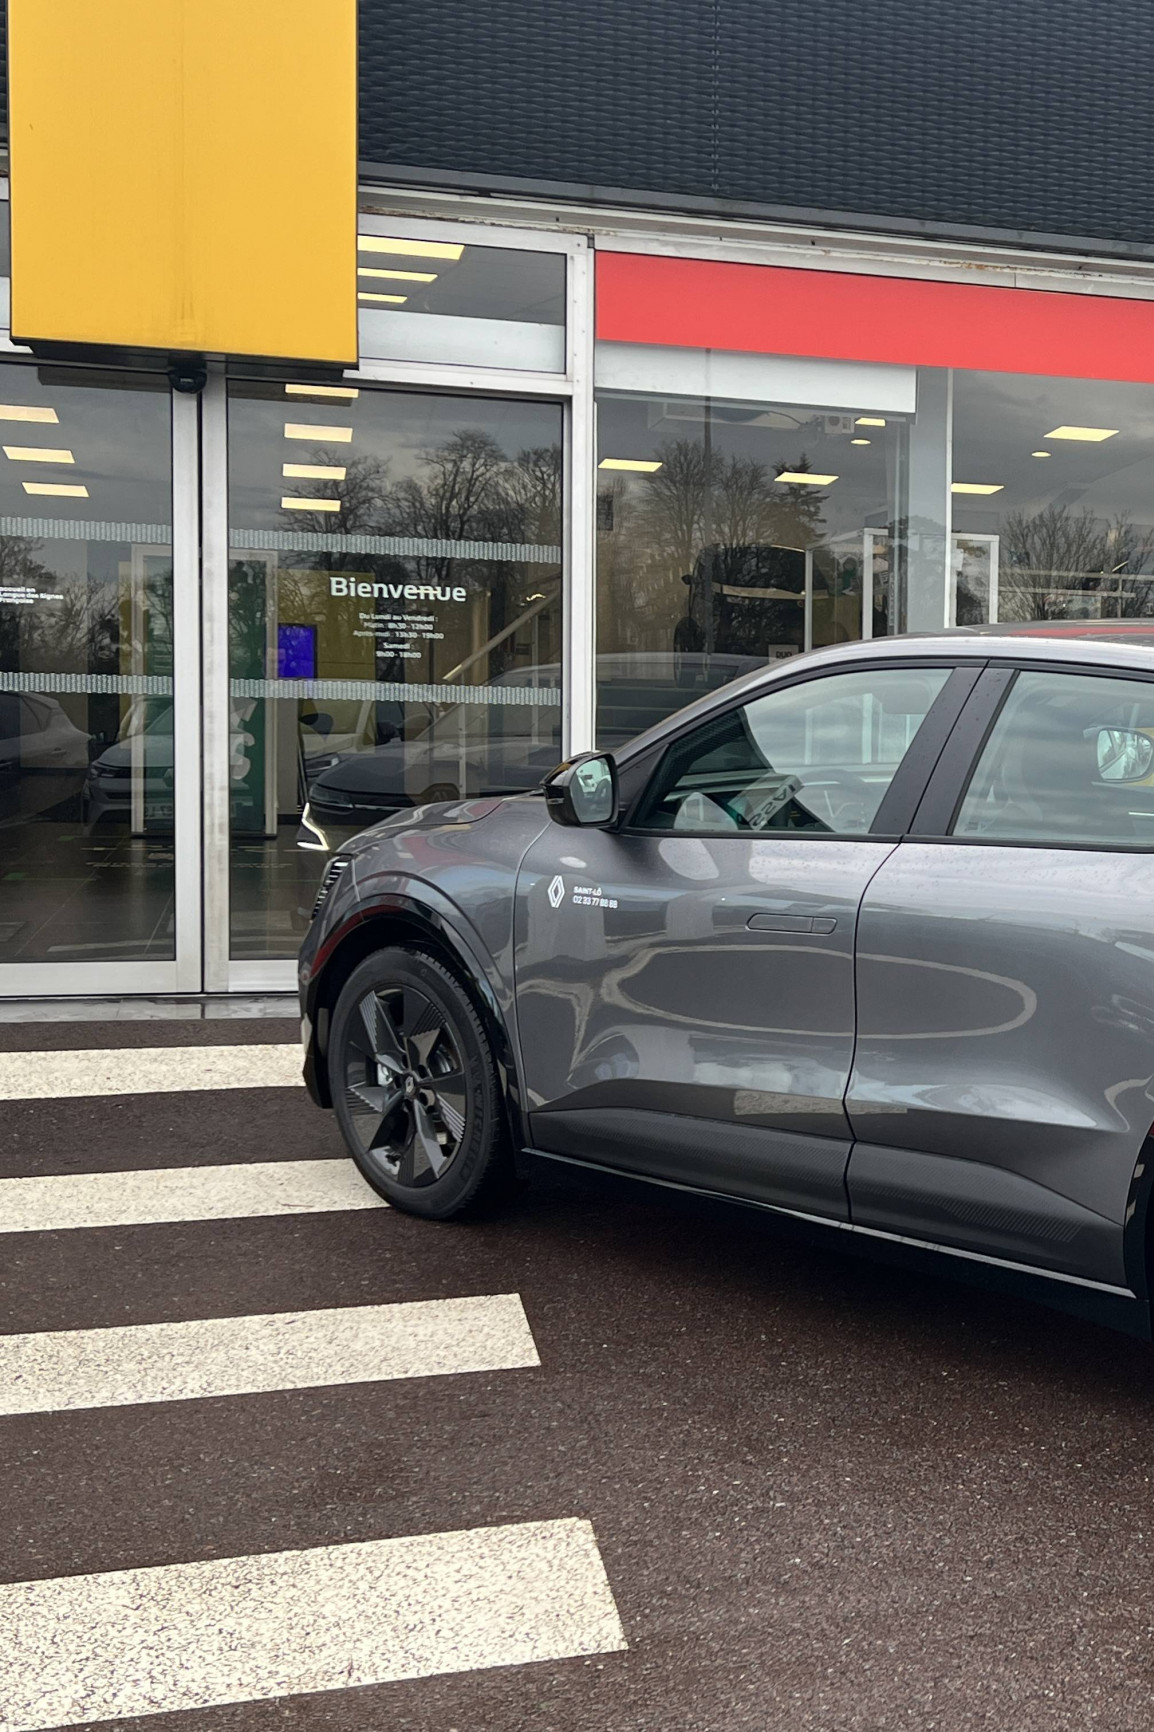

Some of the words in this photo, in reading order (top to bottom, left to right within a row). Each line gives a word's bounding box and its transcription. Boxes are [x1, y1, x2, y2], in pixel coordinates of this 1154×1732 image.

[329, 576, 467, 602] Bienvenue
[402, 614, 435, 622] Vendredi
[382, 642, 411, 650] Samedi
